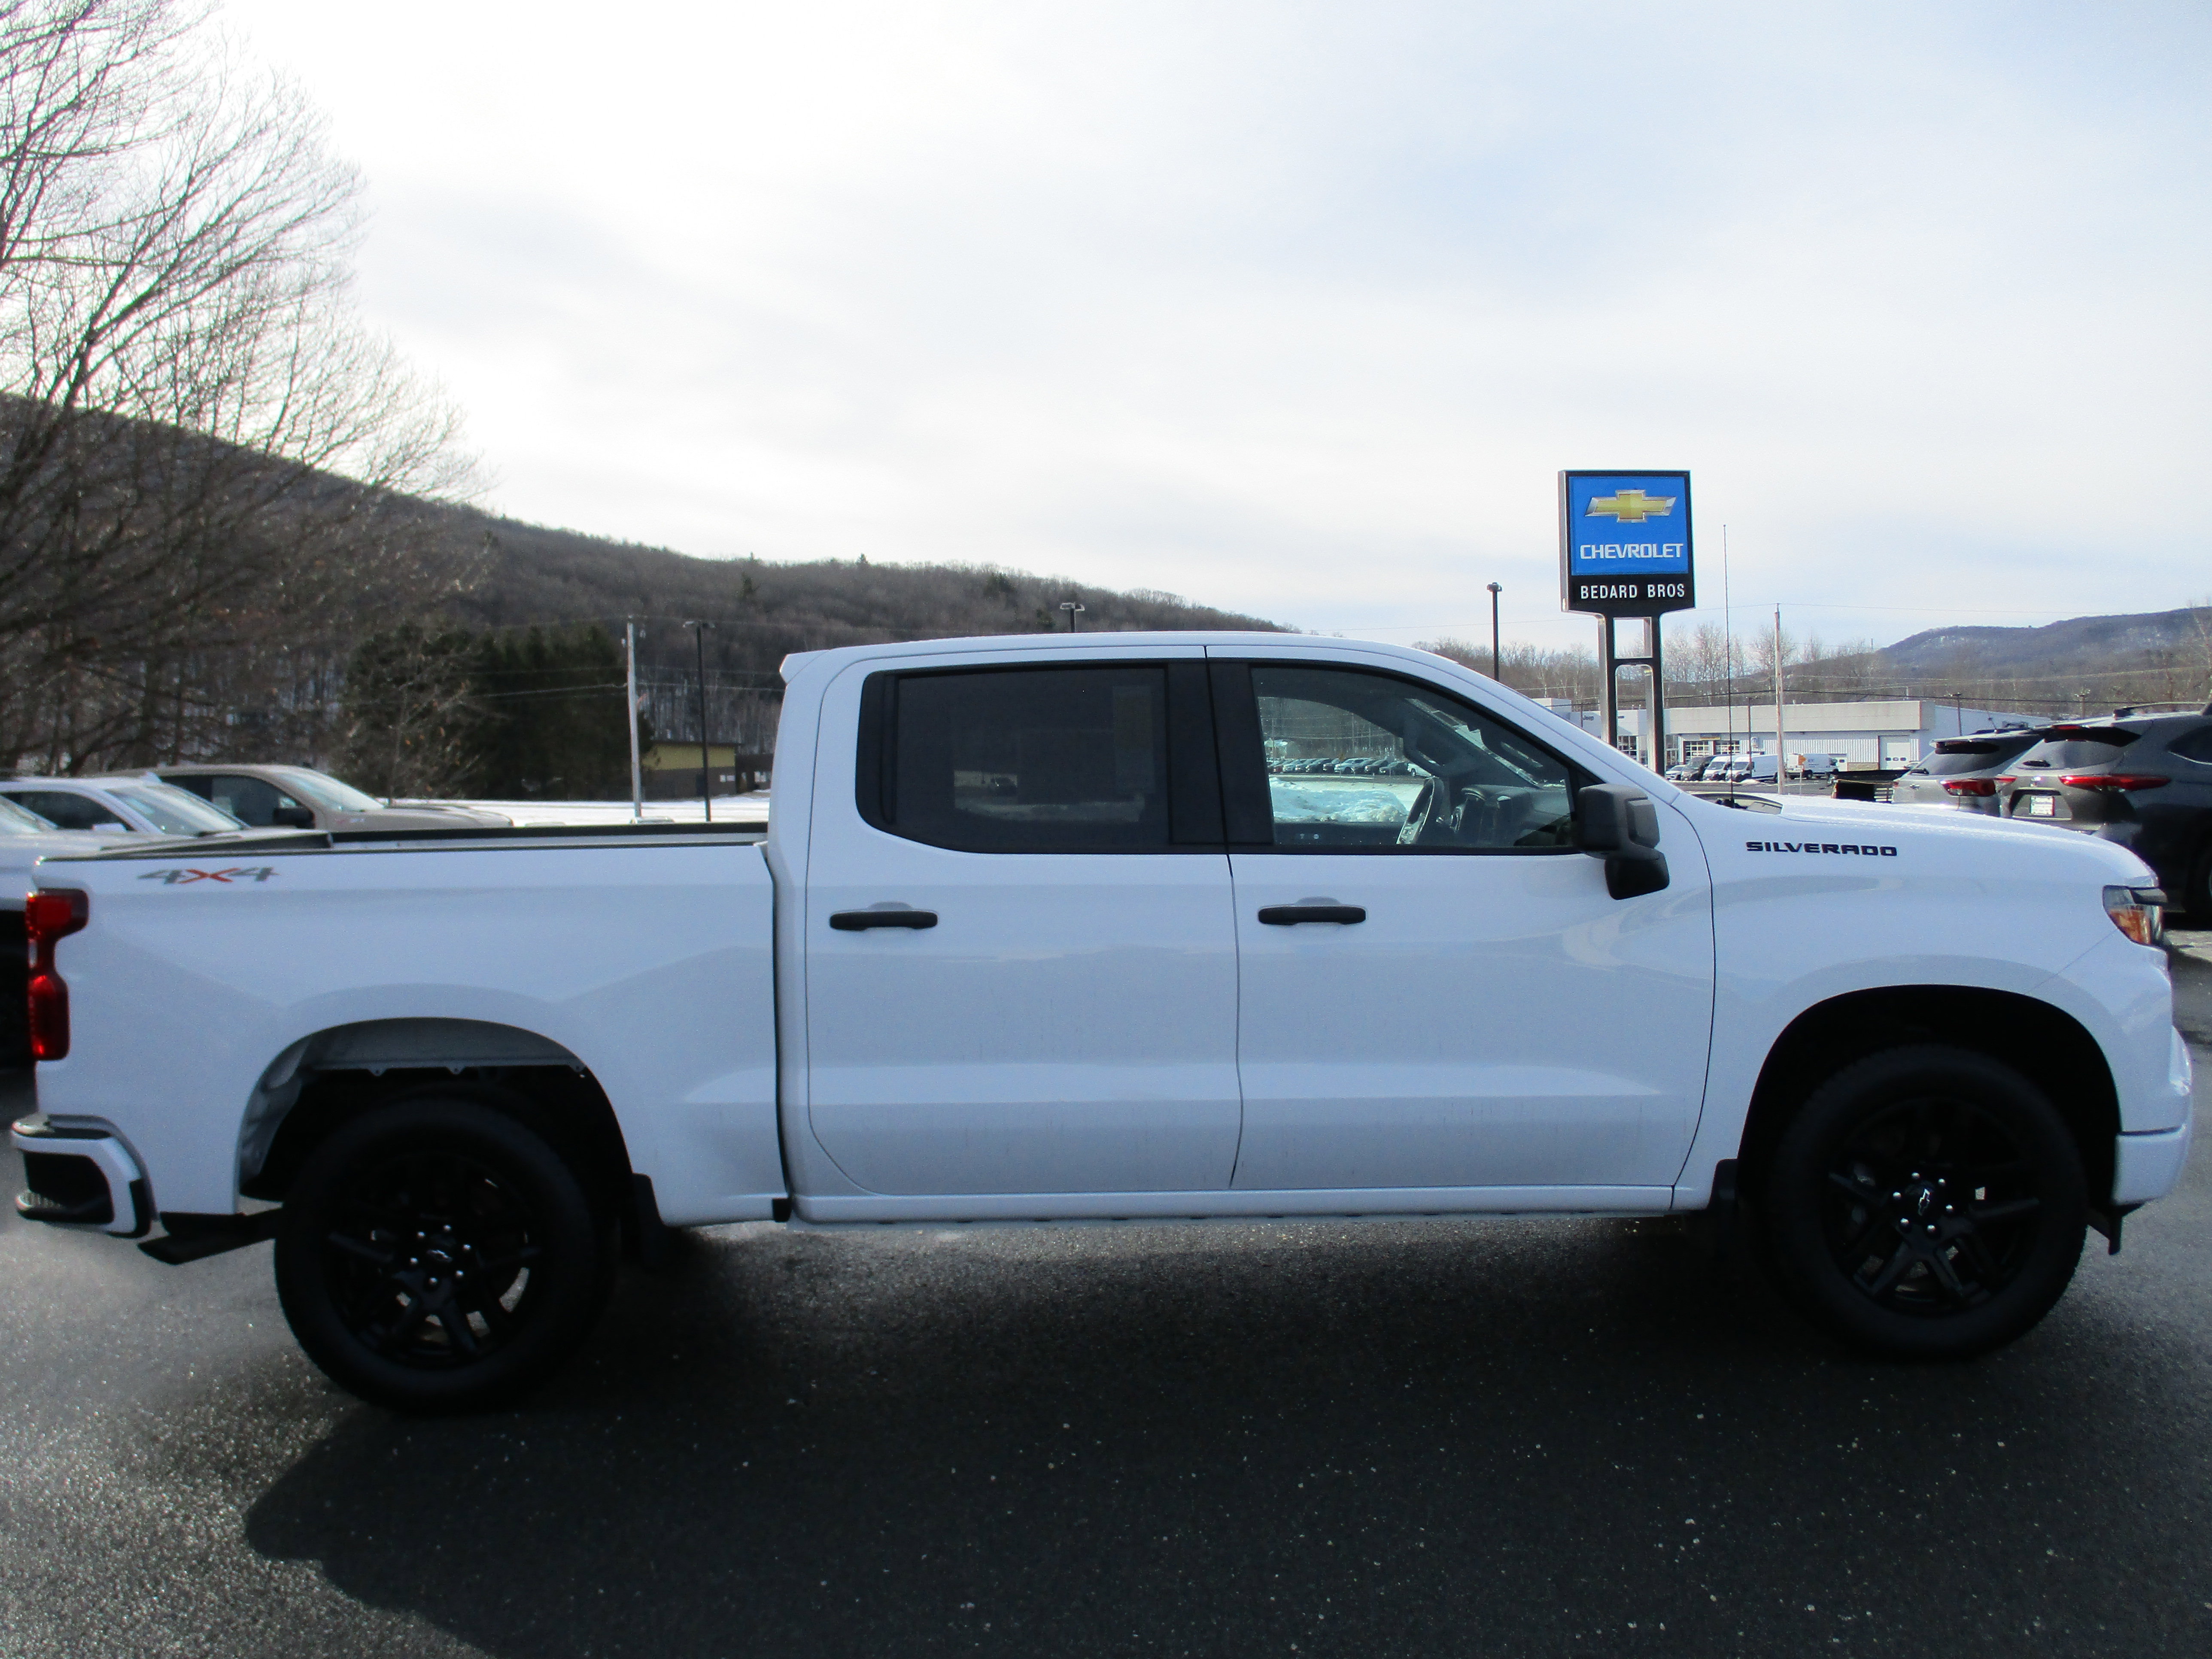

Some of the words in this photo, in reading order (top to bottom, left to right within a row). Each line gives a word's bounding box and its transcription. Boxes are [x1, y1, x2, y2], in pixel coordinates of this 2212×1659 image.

[1580, 544, 1683, 559] CHEVROLET
[1581, 585, 1638, 599] BEDARD
[1647, 583, 1685, 597] BROS
[1746, 842, 1897, 856] SILVERADO
